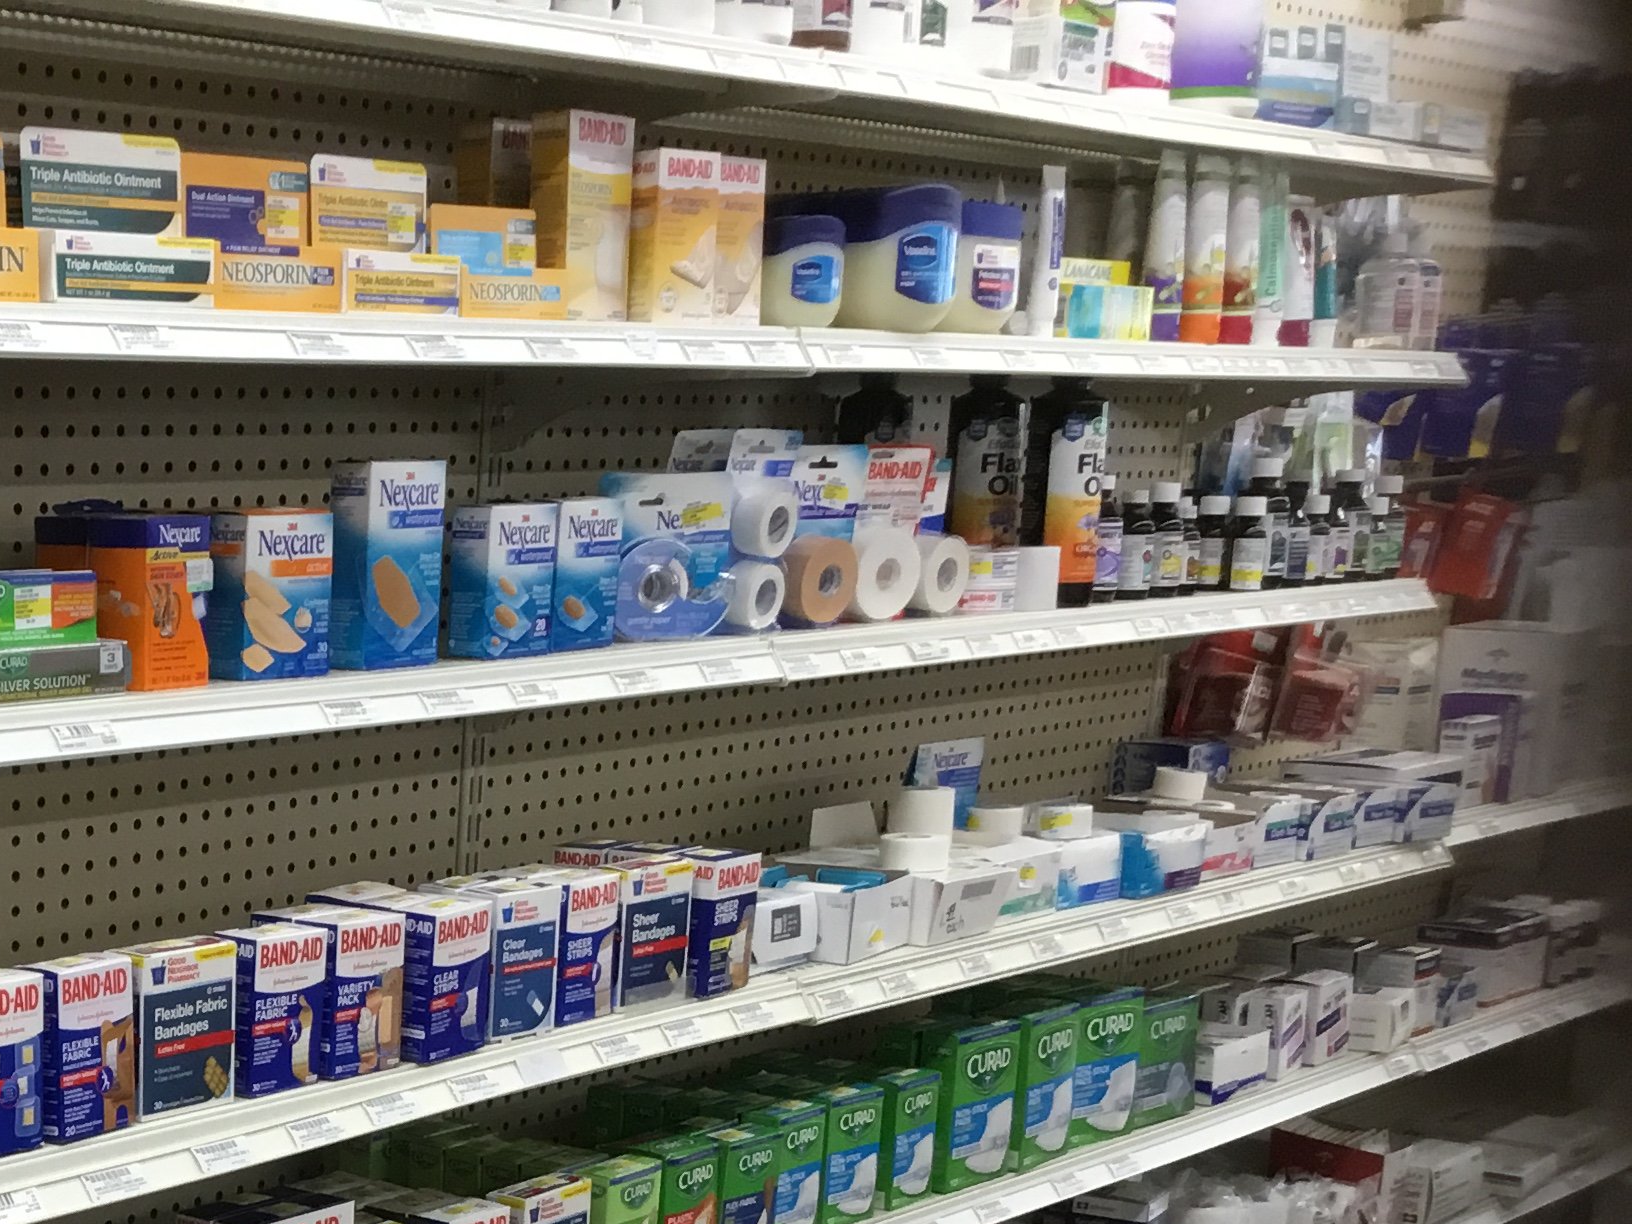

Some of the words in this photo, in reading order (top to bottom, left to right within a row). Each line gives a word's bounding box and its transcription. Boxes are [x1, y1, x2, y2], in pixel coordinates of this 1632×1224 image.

[578, 117, 626, 146] BAND-AID
[30, 166, 62, 183] Triple
[63, 171, 111, 187] Antibiotic
[115, 173, 162, 190] Ointment
[222, 261, 312, 285] NEOSPORIN
[1063, 262, 1112, 282] LANACANE
[869, 461, 922, 480] BAND-AID
[379, 478, 439, 510] Nexcare
[159, 523, 201, 546] Nexcare
[258, 529, 325, 561] Nexcare
[34, 674, 87, 691] SOLUTION
[571, 882, 617, 912] BAND-AID
[633, 913, 658, 929] Sheer
[632, 924, 675, 944] Bandages
[261, 936, 322, 968] BAND-AID
[63, 968, 127, 1005] BAND-AID
[1087, 1013, 1133, 1042] CURAD
[1150, 1014, 1186, 1039] CURAD
[968, 1047, 1010, 1081] CURAD
[678, 1165, 713, 1190] CURAD
